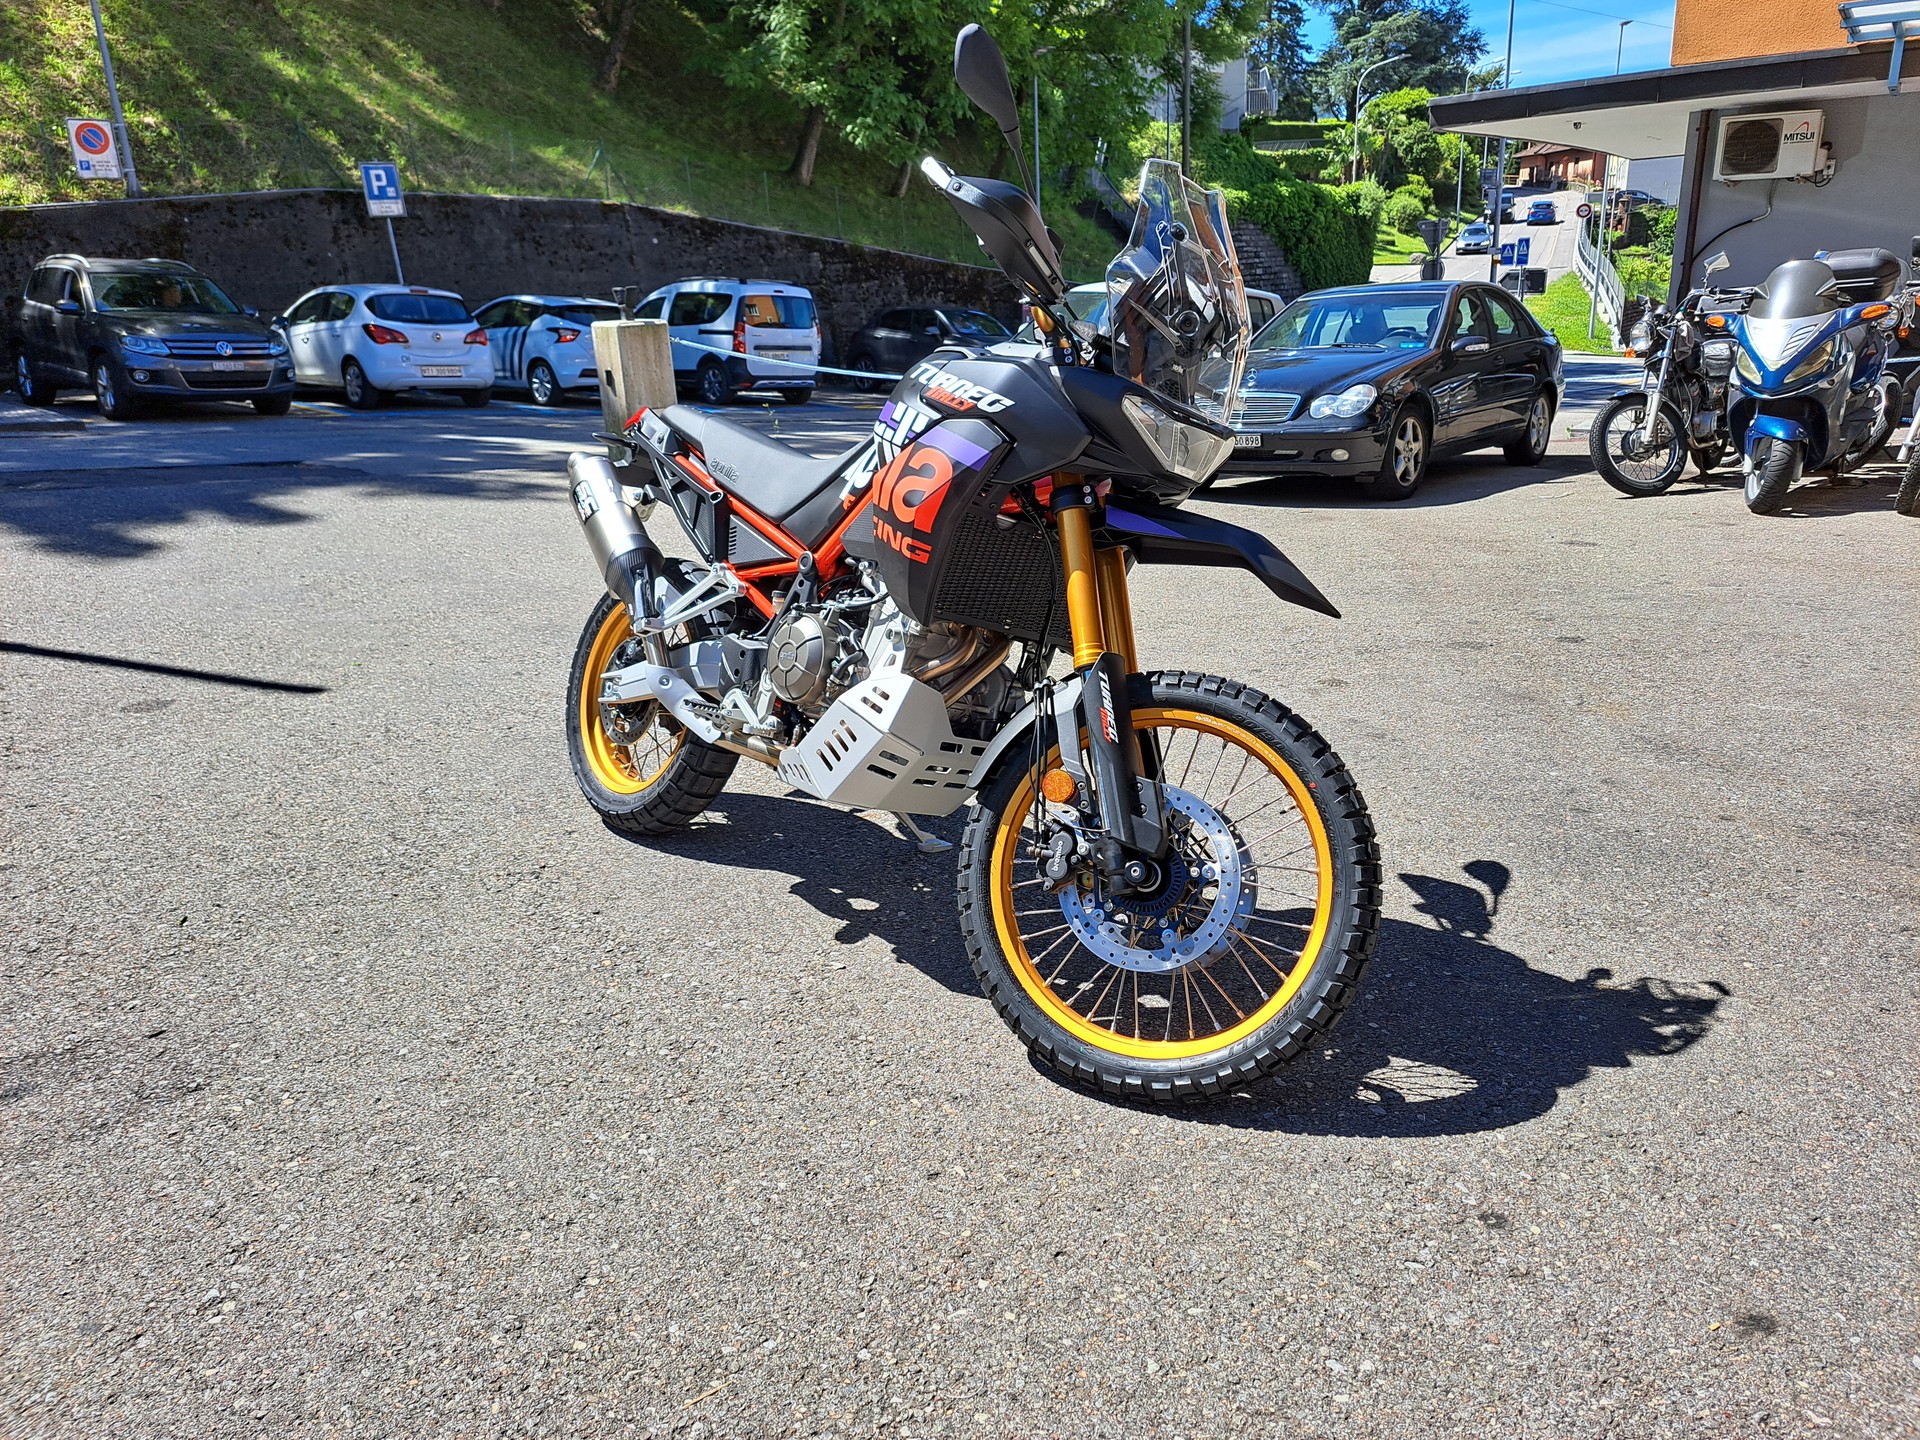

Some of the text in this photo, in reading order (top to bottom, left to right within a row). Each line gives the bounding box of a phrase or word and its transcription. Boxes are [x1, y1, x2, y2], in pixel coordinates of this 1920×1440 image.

[1784, 132, 1815, 141] MITSUI
[369, 169, 388, 196] P
[909, 361, 1016, 413] TUAREG
[926, 386, 976, 413] RALLY
[1245, 436, 1260, 446] 898
[710, 459, 740, 484] aprilia
[1098, 670, 1119, 744] TUAREG
[1051, 840, 1063, 871] brembo
